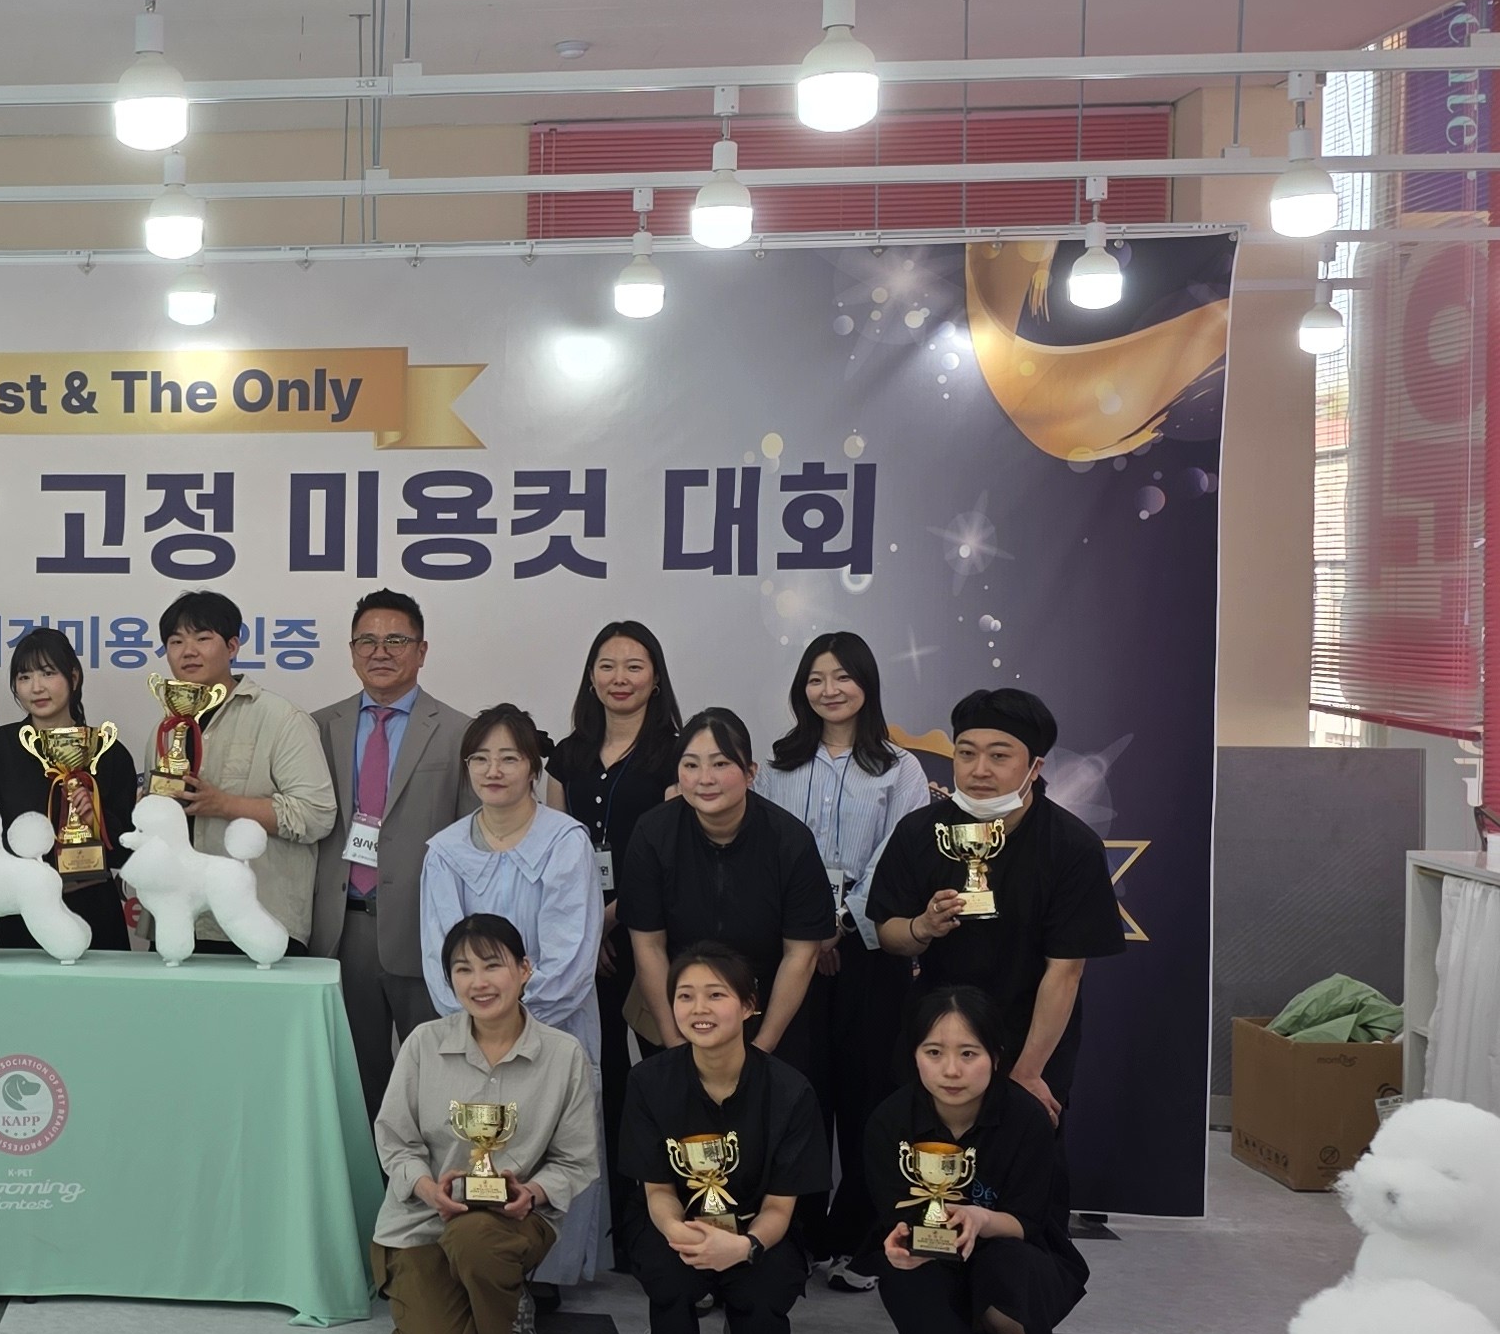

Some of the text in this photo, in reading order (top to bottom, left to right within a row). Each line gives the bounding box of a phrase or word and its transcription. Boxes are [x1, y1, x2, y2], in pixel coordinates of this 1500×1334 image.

[60, 370, 100, 415] &
[110, 370, 218, 415] The
[232, 368, 363, 424] Only
[35, 471, 236, 581] 고정
[288, 467, 609, 581] 미용컷
[661, 461, 878, 578] 대회
[230, 616, 321, 671] 인증
[48, 1074, 60, 1086] OF
[56, 1087, 66, 1106] PET
[1, 1115, 41, 1127] KAPP
